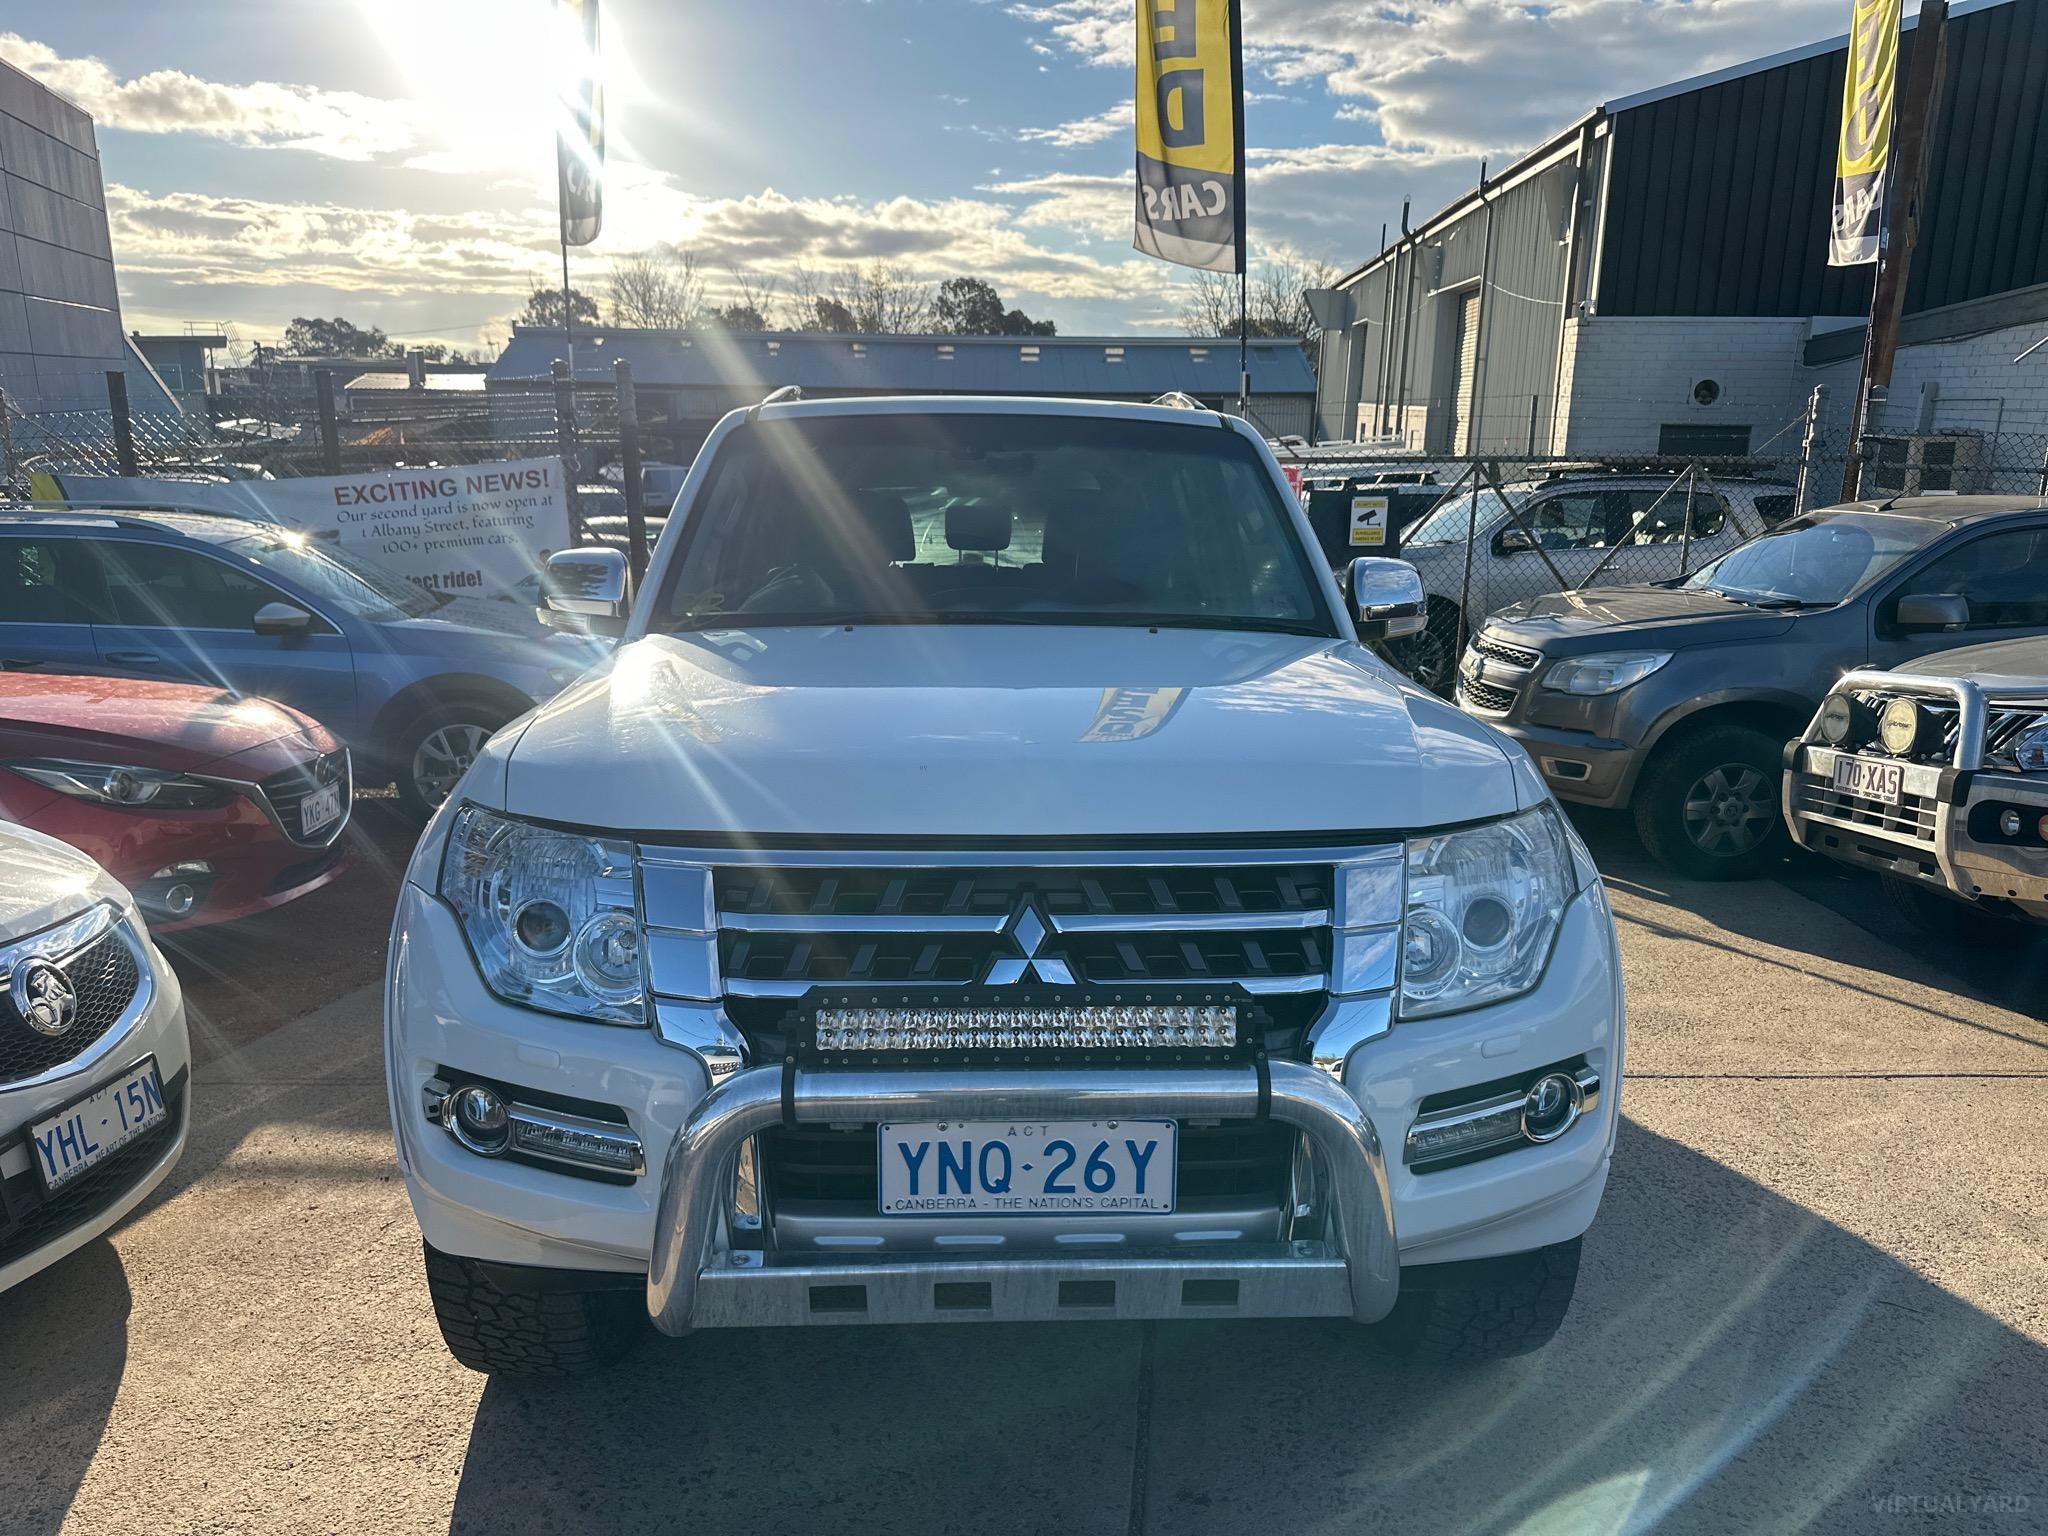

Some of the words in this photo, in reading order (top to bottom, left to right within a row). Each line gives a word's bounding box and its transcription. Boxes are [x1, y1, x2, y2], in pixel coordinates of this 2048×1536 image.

[334, 478, 458, 506] EXCITING
[465, 468, 549, 495] NEWS!
[336, 510, 367, 524] Our
[370, 504, 417, 520] second
[422, 501, 453, 520] yard
[457, 500, 468, 514] is
[472, 501, 502, 512] now
[504, 497, 537, 512] open
[541, 495, 552, 506] at
[371, 522, 421, 539] Albany
[424, 517, 469, 534] Street,
[472, 514, 535, 529] featuring
[383, 540, 418, 554] 100+
[424, 532, 484, 553] premium
[488, 532, 519, 546] cars.
[443, 570, 483, 588] ride!
[1007, 1125, 1049, 1137] ACT
[48, 1161, 89, 1189] CANBERRA
[95, 1141, 118, 1162] HEART
[119, 1134, 128, 1146] OF
[128, 1126, 142, 1140] THE
[895, 1198, 977, 1210] CANBERRA
[995, 1197, 1022, 1208] THE
[1029, 1197, 1094, 1208] NATION'S
[1100, 1197, 1158, 1209] CAPITAL
